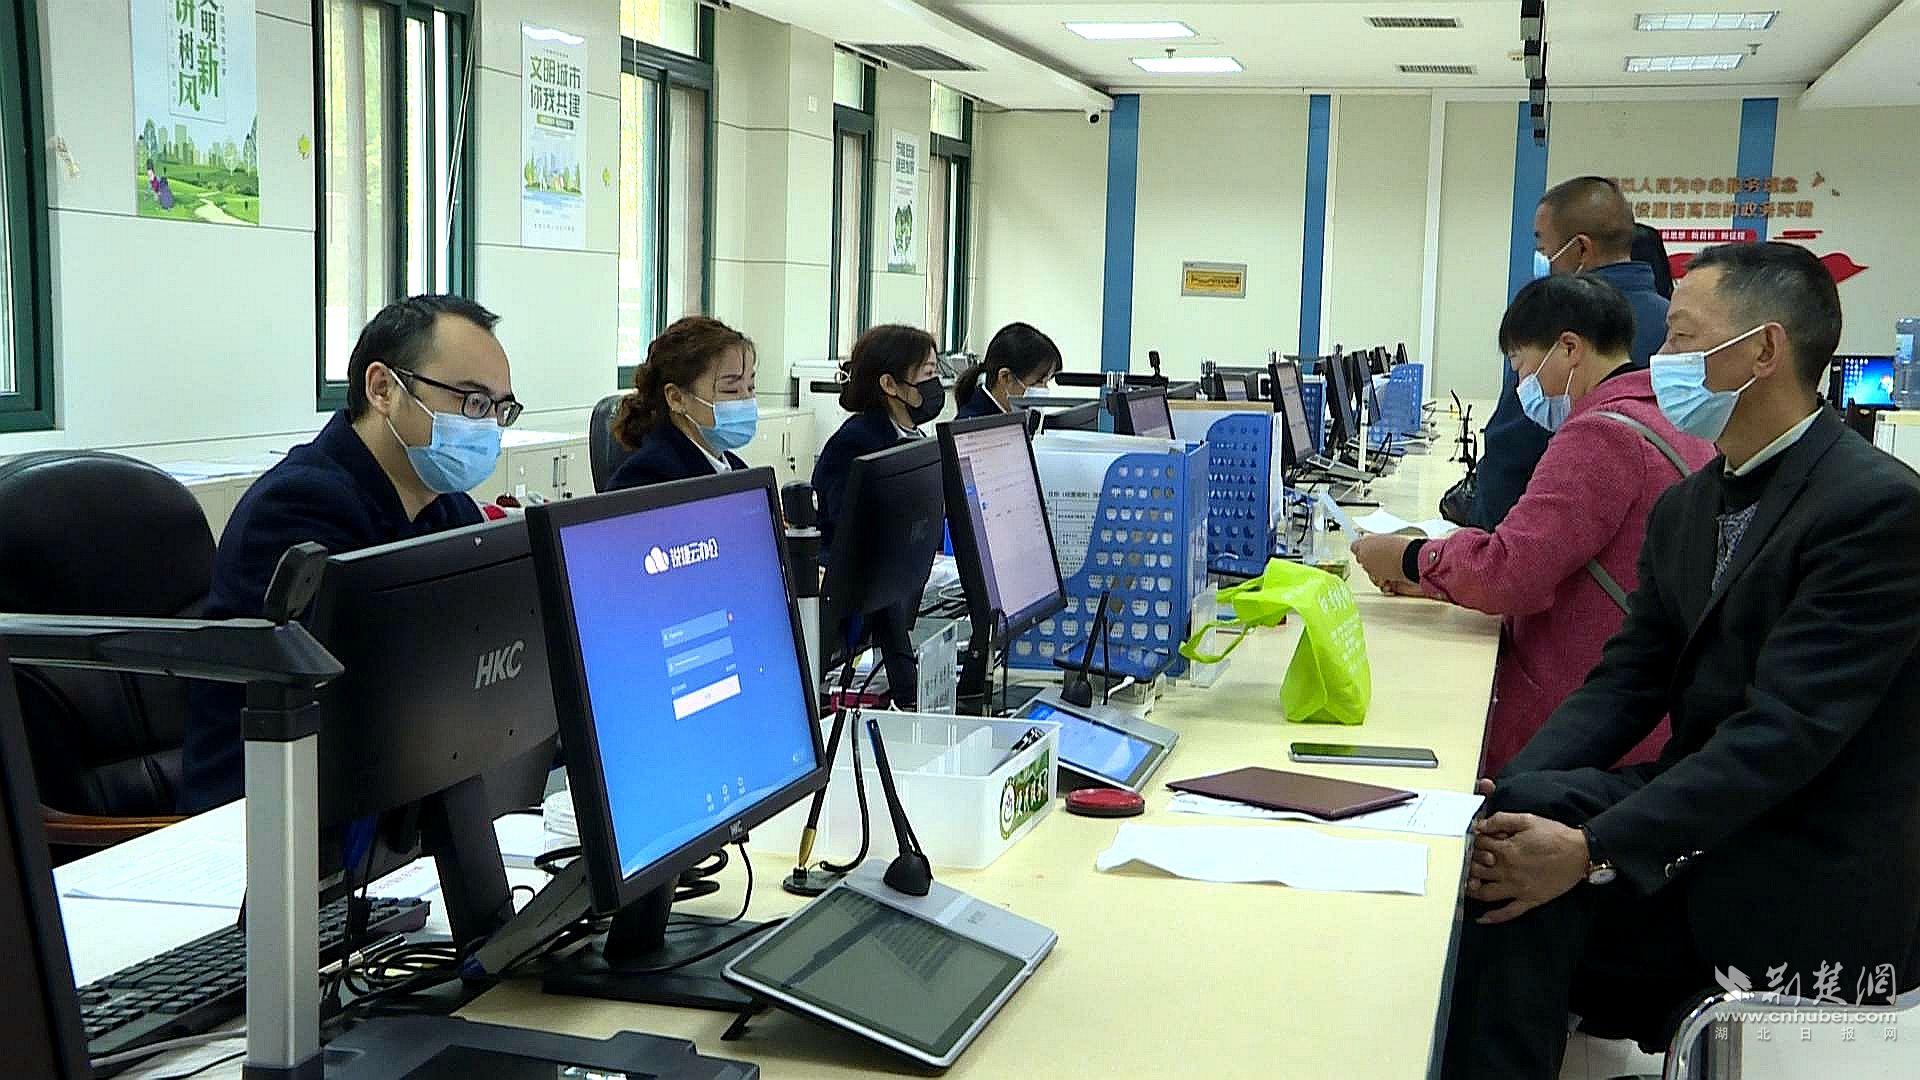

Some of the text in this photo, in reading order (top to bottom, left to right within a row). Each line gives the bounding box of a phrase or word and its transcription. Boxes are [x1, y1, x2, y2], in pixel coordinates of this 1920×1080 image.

[530, 56, 580, 89] 文明城市
[530, 83, 580, 118] 你我共建
[475, 640, 524, 689] HKC
